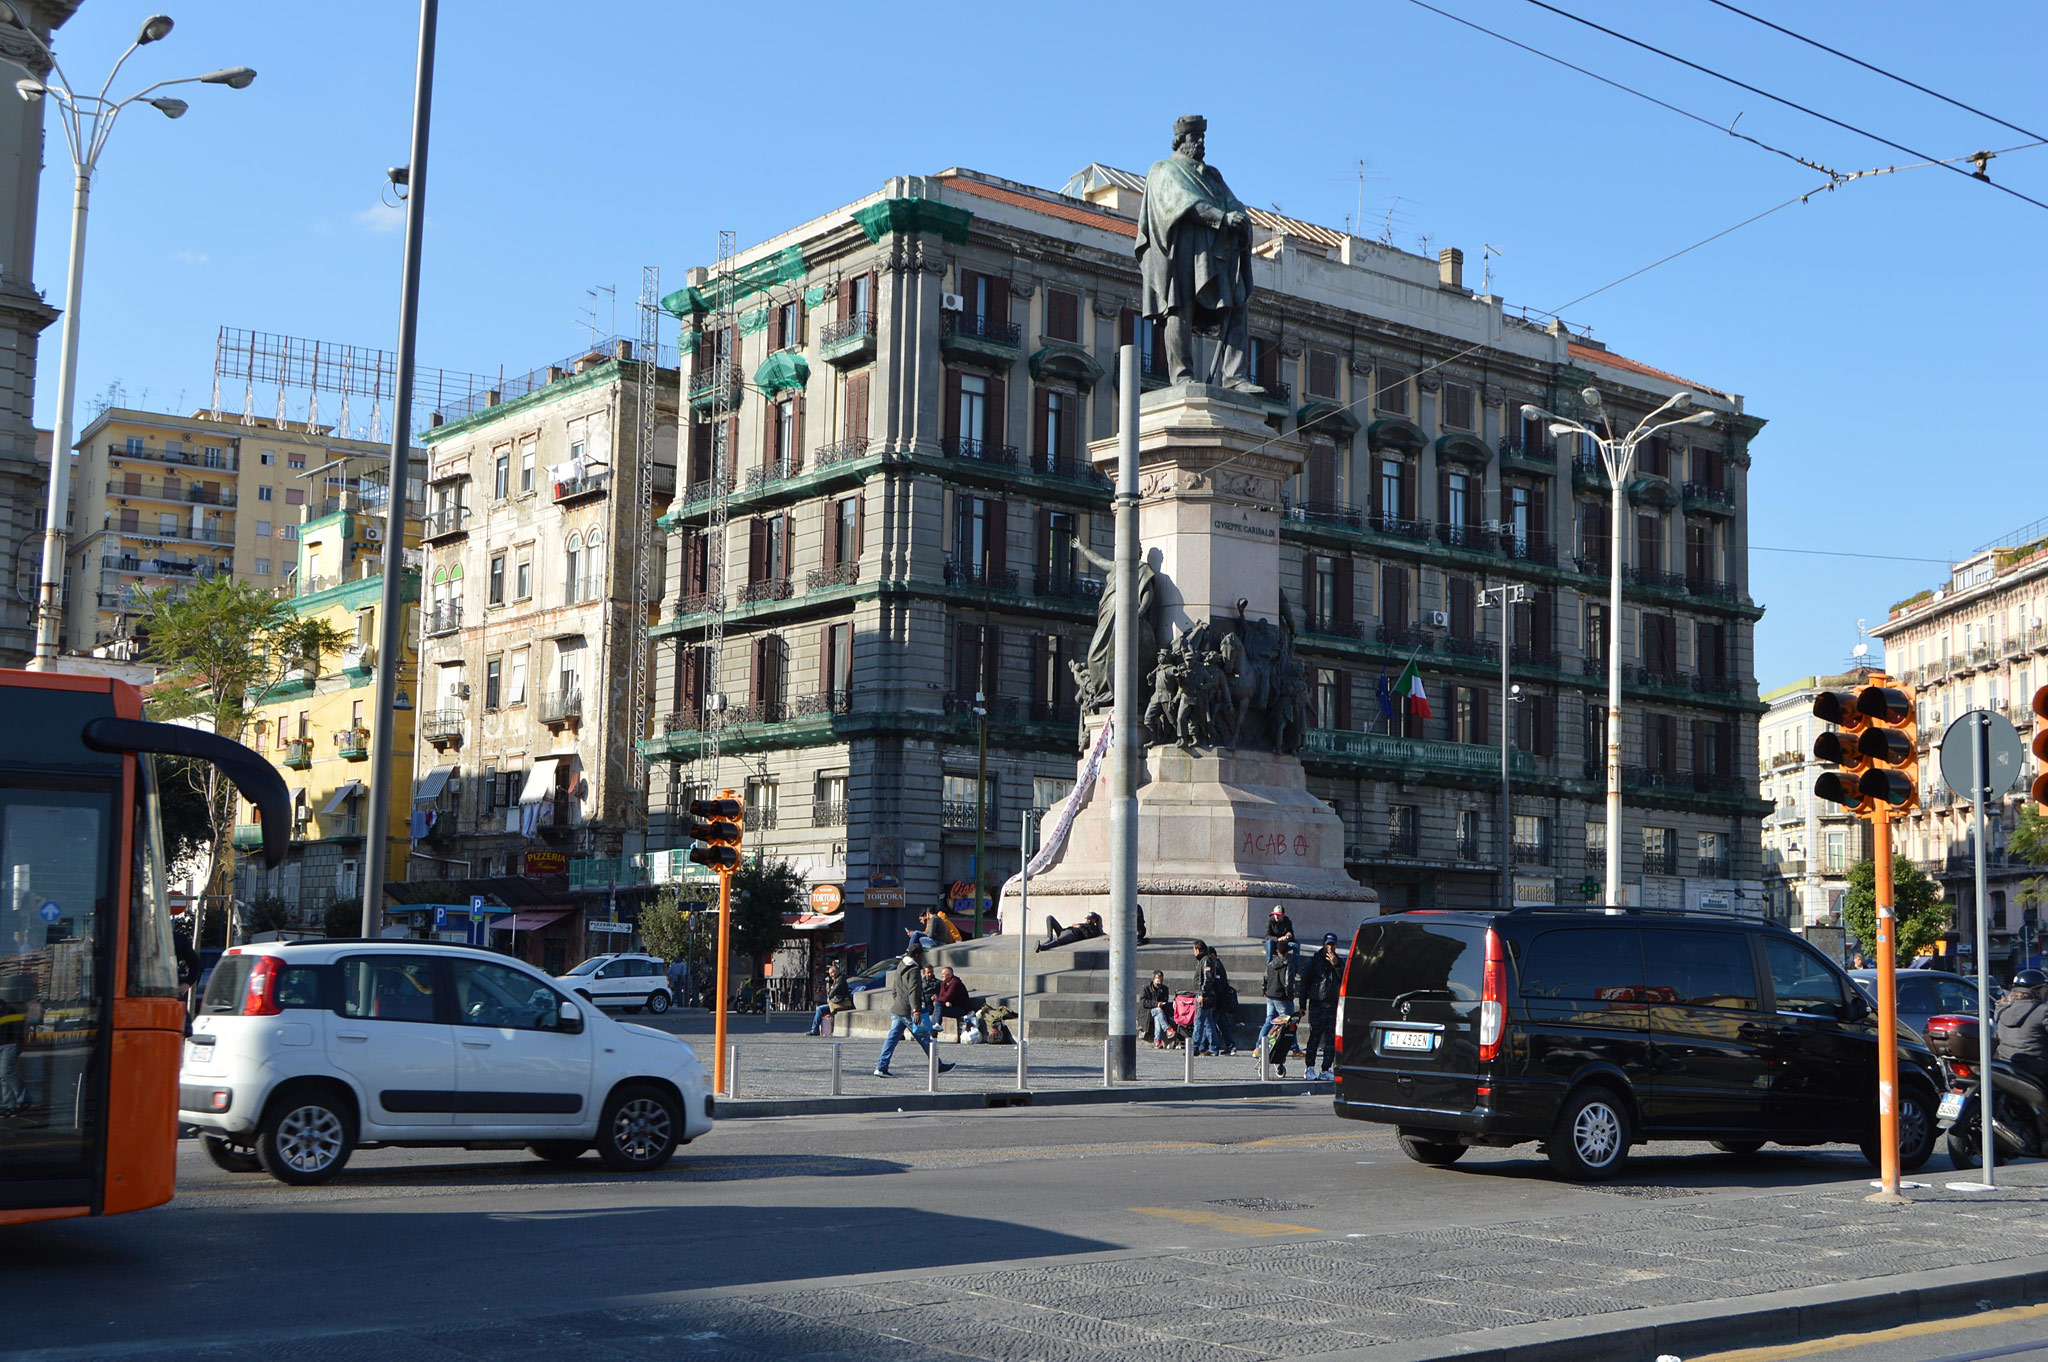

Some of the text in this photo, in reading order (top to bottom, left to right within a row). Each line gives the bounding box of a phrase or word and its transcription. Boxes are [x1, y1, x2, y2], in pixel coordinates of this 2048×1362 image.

[1243, 512, 1248, 520] A
[1242, 831, 1287, 856] ACAB
[527, 851, 566, 864] PIZZERIA
[950, 880, 976, 899] Ciao
[1515, 882, 1555, 903] Farmacia
[812, 893, 840, 903] TORTORA
[474, 899, 482, 912] P
[436, 908, 445, 923] P
